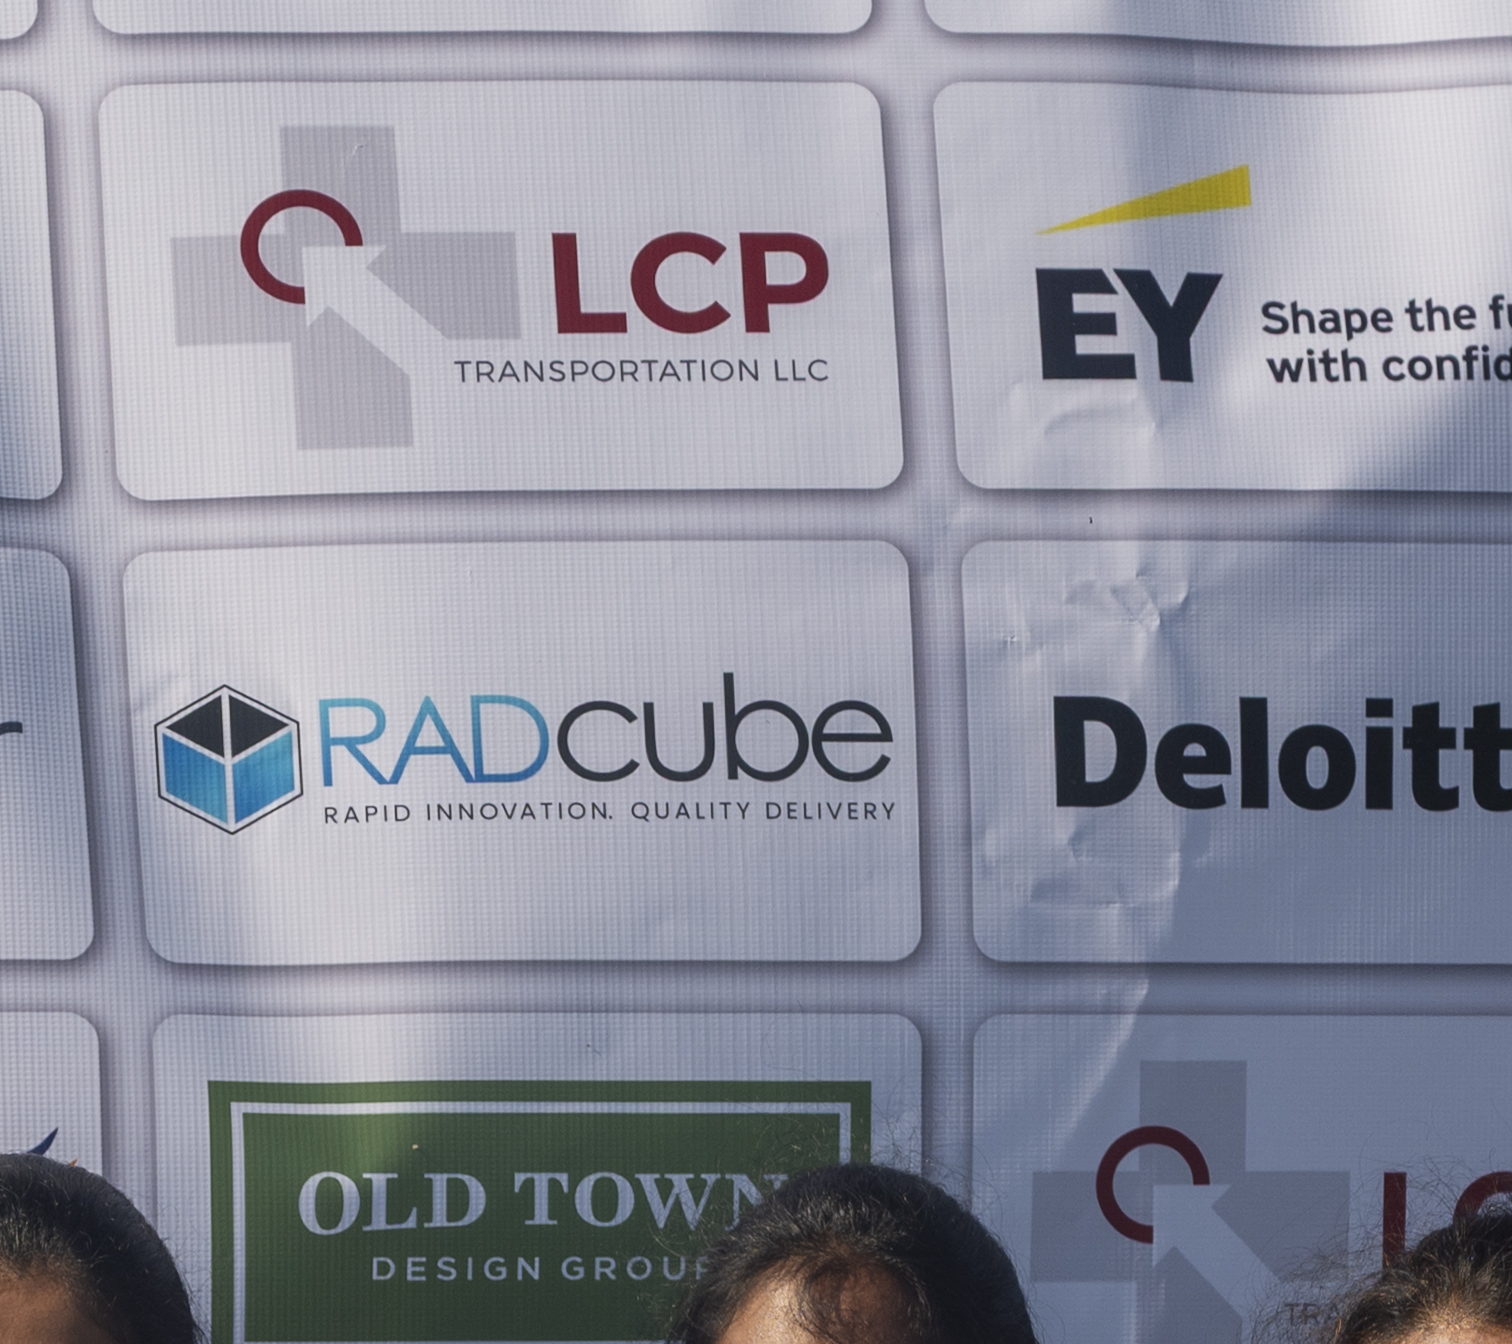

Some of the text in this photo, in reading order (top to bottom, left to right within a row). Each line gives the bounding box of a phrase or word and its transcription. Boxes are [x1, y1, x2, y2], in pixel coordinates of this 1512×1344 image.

[552, 231, 830, 335] LCP
[1035, 267, 1223, 383] EY
[1261, 300, 1393, 340] Shape
[1406, 297, 1478, 332] the
[454, 358, 830, 383] TRANSPORTATION LLC
[1266, 346, 1368, 383] with
[324, 801, 896, 825] RAPID INNOVATION. QUALITY DELIVERY
[298, 1171, 487, 1236] OLD
[372, 1255, 541, 1281] DESIGN
